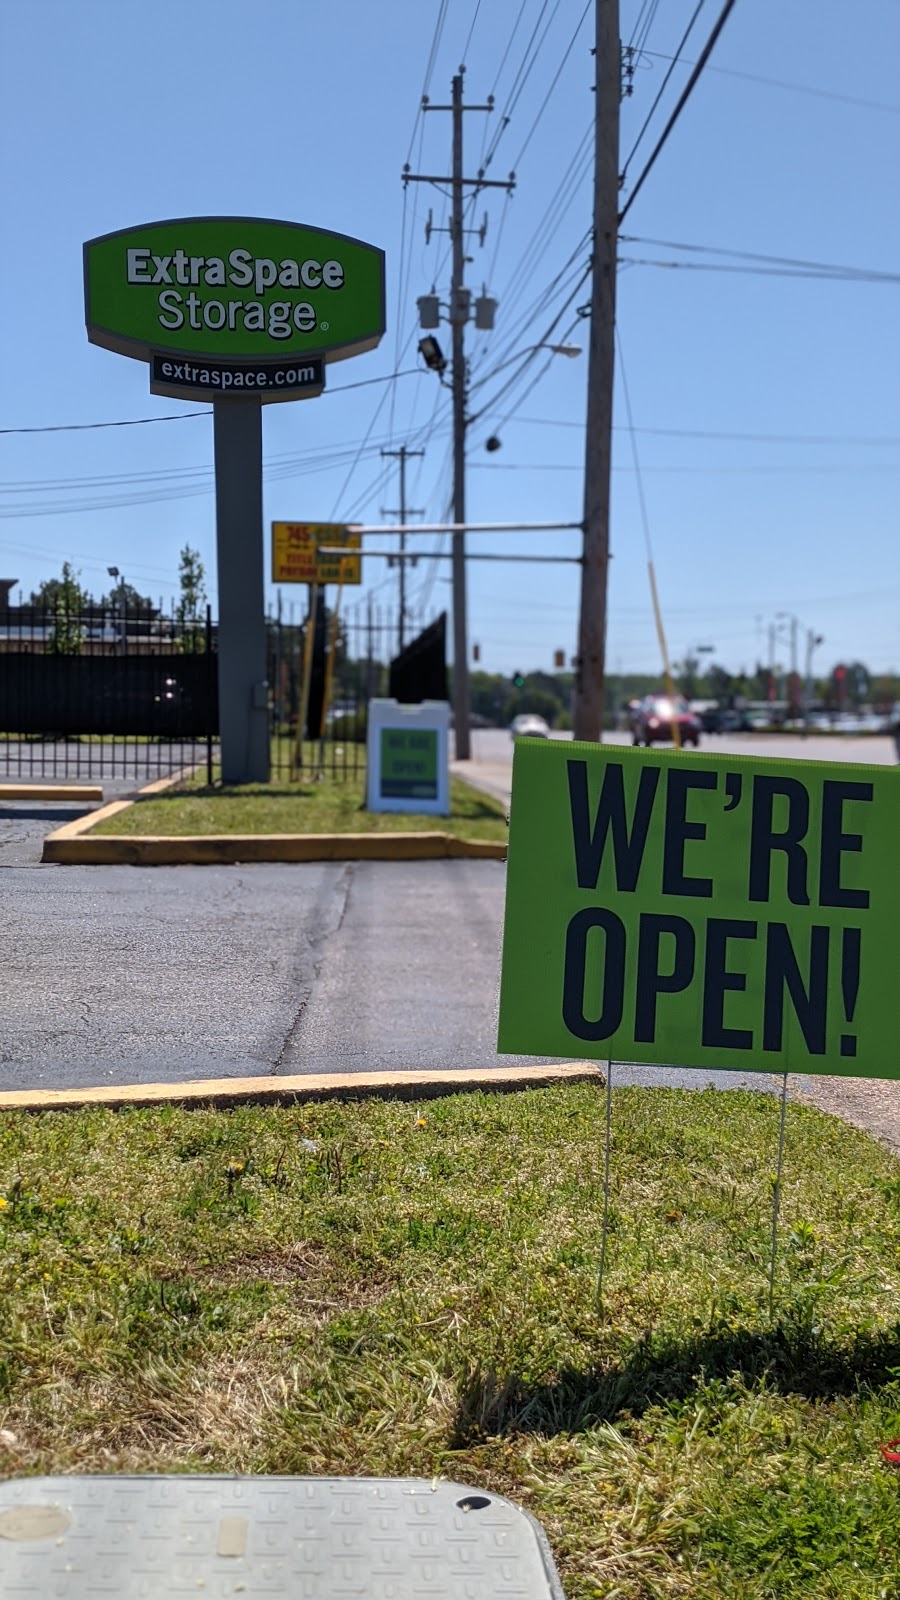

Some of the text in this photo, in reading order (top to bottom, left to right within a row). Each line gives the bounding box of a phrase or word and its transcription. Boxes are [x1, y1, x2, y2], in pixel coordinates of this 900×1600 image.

[157, 289, 317, 340] Storage
[160, 361, 315, 389] extraspace.com
[566, 759, 874, 909] WE'RE
[562, 906, 862, 1057] OPEN!
